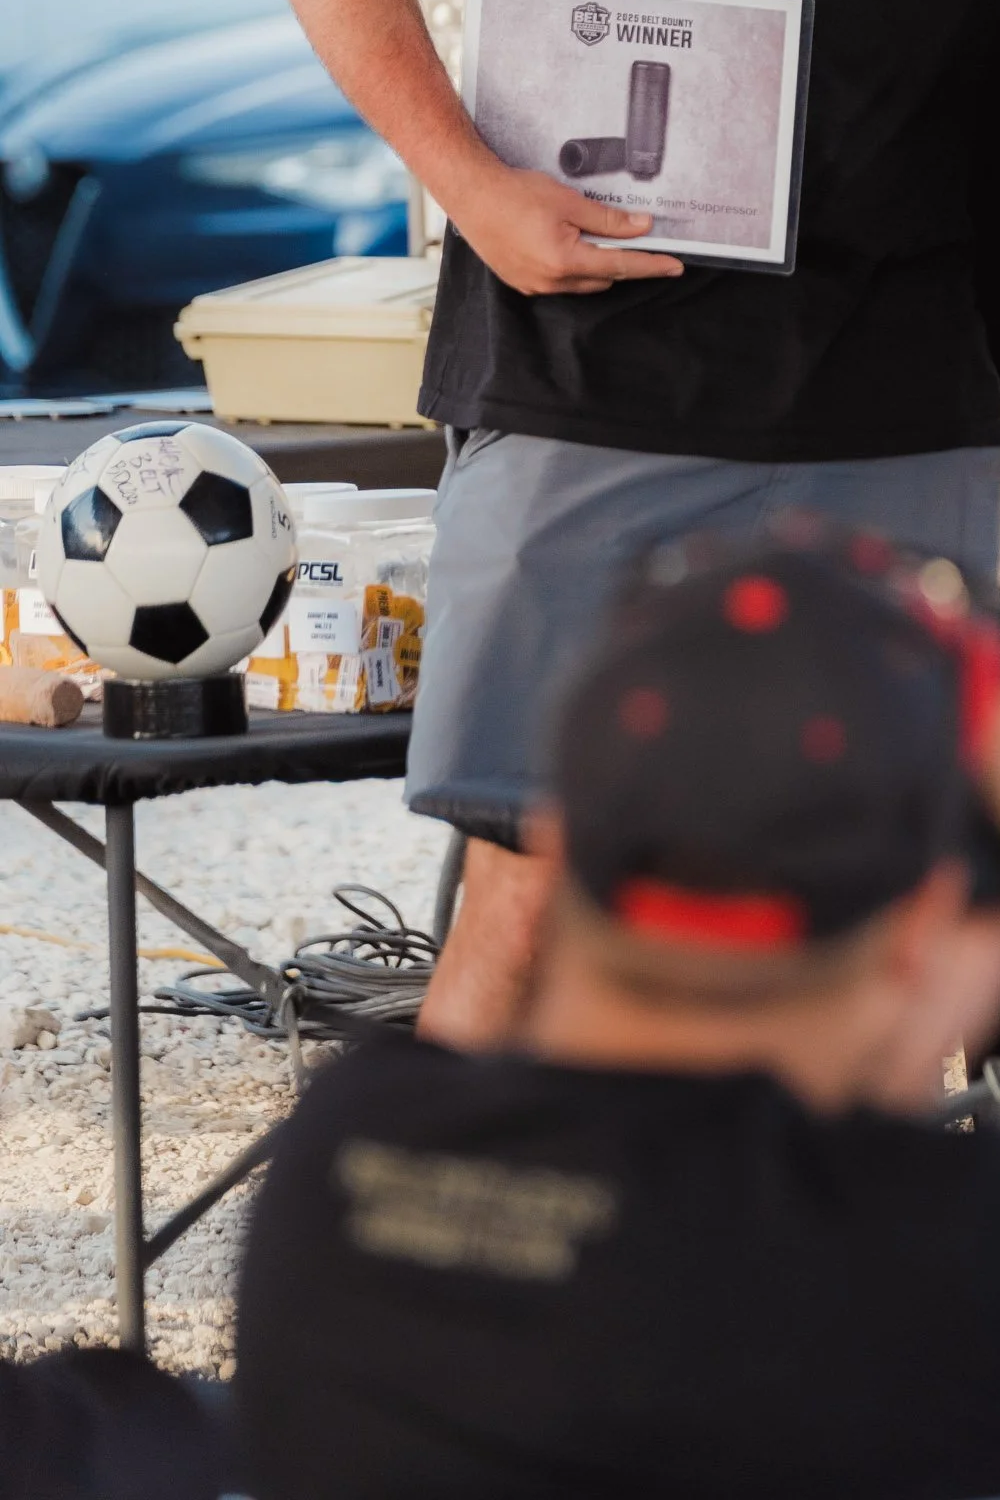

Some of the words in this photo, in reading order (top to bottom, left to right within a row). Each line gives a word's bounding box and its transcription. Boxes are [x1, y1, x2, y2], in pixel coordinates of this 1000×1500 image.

[574, 11, 609, 25] BELT
[616, 12, 639, 23] 2025
[641, 15, 660, 25] BELT
[661, 17, 694, 28] BOUNTY
[616, 23, 693, 49] WINNER
[584, 188, 623, 204] Works
[656, 195, 686, 210] 9mm
[690, 199, 759, 217] Suppressor
[297, 562, 344, 582] PCSL
